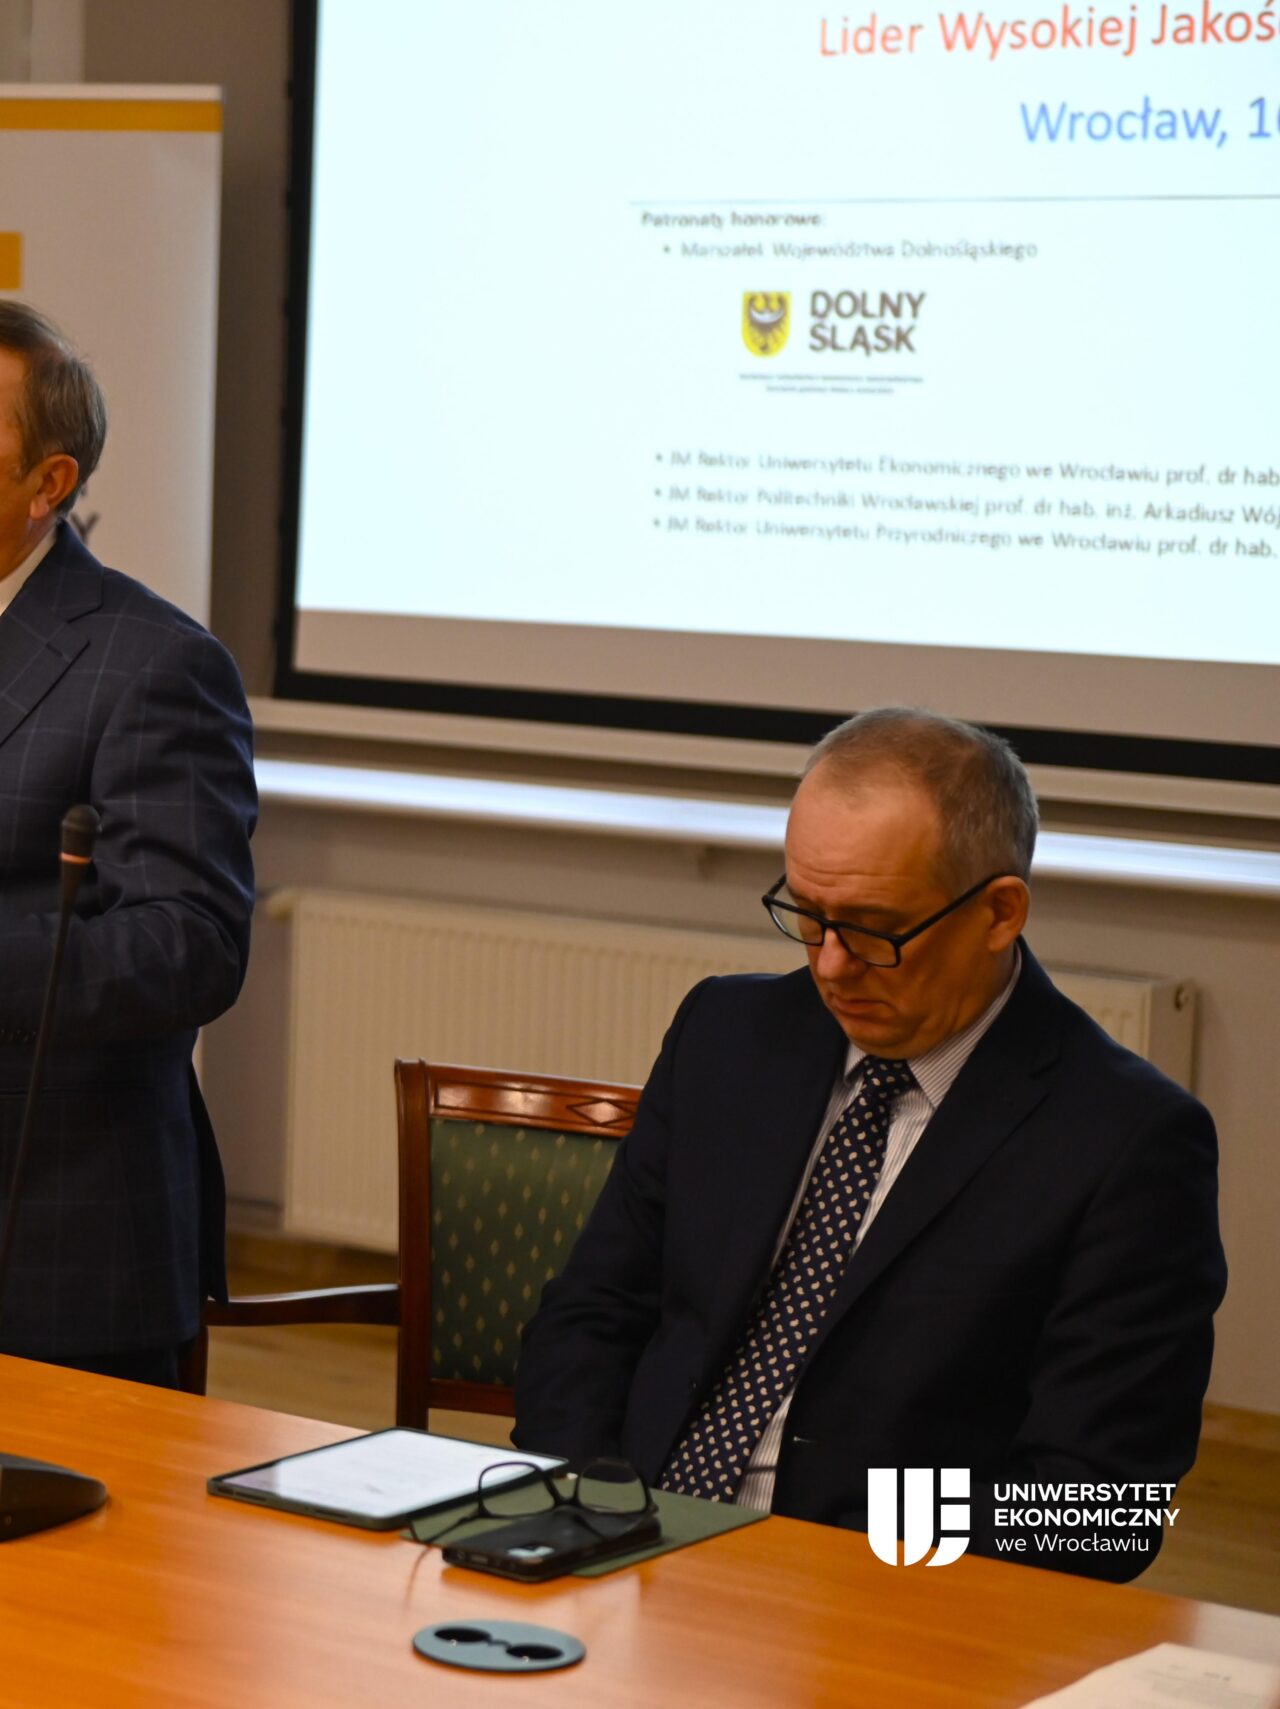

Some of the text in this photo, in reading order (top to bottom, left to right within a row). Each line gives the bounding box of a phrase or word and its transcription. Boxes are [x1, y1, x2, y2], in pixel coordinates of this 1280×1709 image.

[820, 0, 1280, 60] Lider Wysokiej Jakoś
[1021, 96, 1280, 148] Wrocław, 1
[809, 289, 926, 319] DOLNY
[808, 319, 917, 357] ŚLĄSK
[1025, 466, 1053, 478] we
[1059, 462, 1160, 484] Wrocławiu
[1218, 467, 1237, 484] dr
[861, 492, 979, 517] Wrocławskiej
[1034, 499, 1052, 516] dr
[1143, 503, 1235, 524] Arkadiusz
[1018, 534, 1044, 547] we
[1051, 532, 1151, 553] Wrocławiu
[1209, 537, 1229, 555] dr
